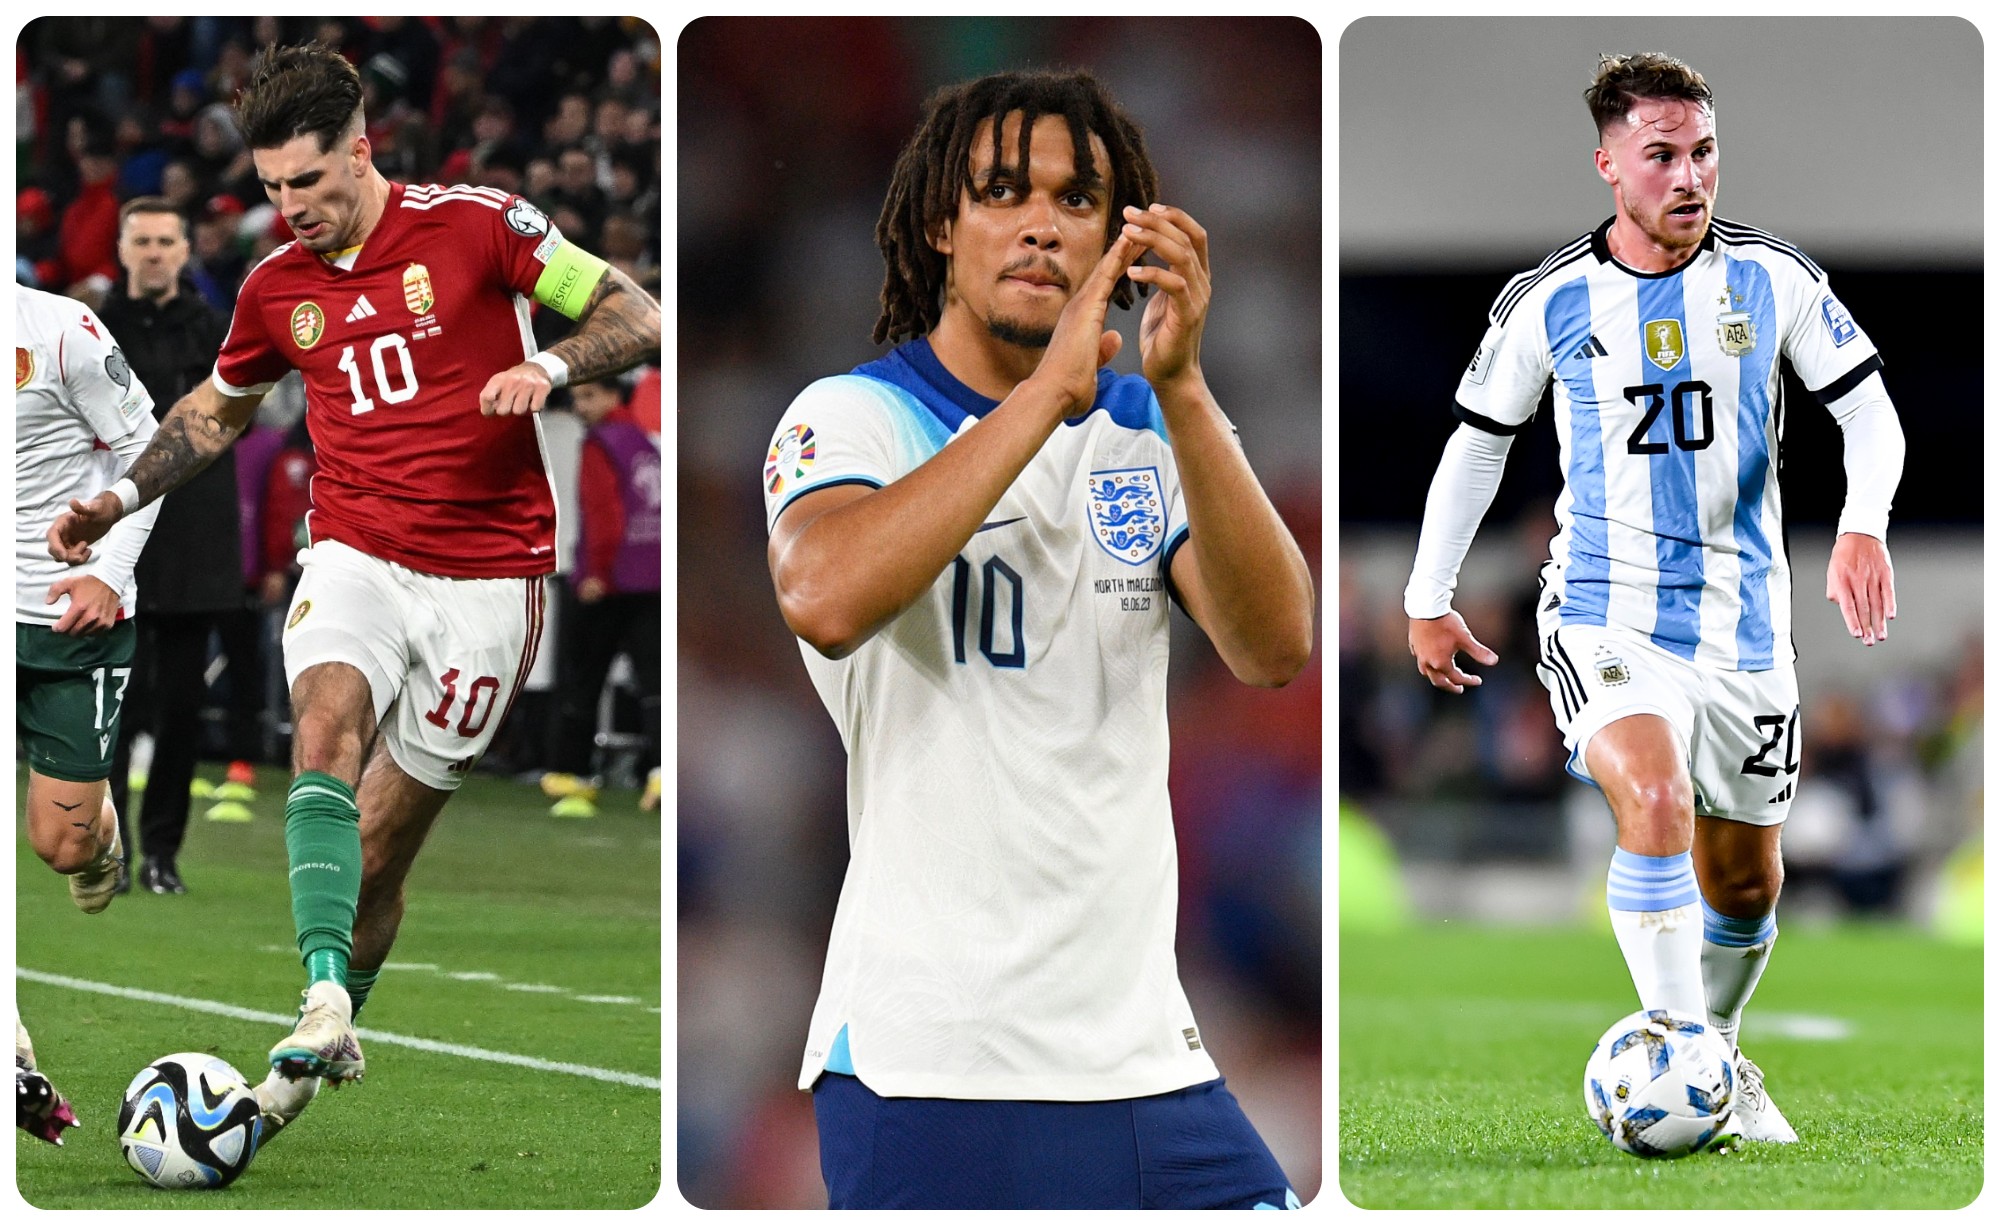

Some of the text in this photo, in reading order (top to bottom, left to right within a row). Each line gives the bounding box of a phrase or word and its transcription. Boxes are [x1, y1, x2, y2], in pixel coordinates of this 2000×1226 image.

[552, 264, 579, 309] RESPECT
[1726, 323, 1748, 344] AFA
[337, 332, 419, 416] 10
[1623, 380, 1714, 454] 20
[951, 553, 1025, 669] 10
[1094, 578, 1124, 594] NORTH
[92, 667, 132, 729] 13
[425, 667, 500, 738] 10
